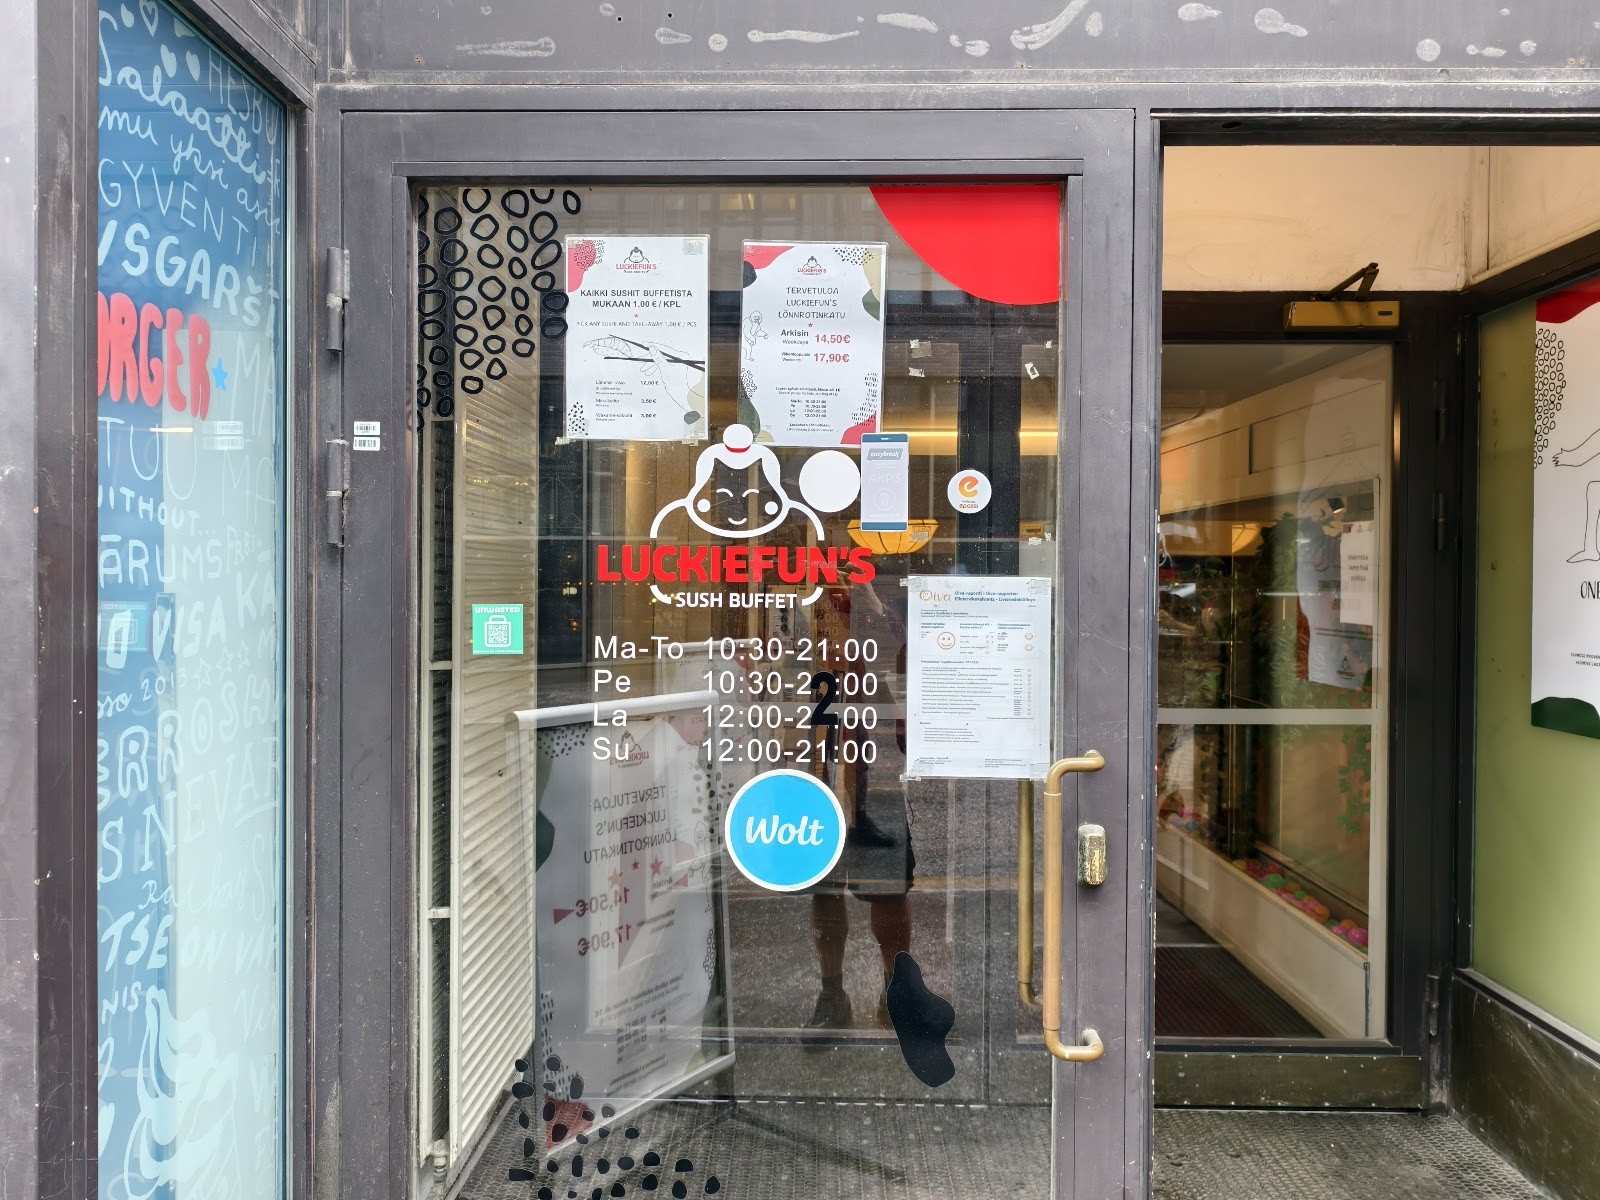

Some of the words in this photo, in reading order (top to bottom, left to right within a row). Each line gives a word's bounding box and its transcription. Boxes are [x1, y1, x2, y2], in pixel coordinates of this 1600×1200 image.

[580, 289, 608, 297] KAIKKI
[786, 287, 839, 295] TERVETULOA
[592, 300, 631, 308] MUKAAN
[786, 299, 838, 307] LUCKIEFUN'S
[778, 310, 846, 319] LÖNNROTINKATU
[780, 329, 809, 337] Arkisin
[814, 334, 851, 344] 14,50€
[814, 353, 850, 363] 17,90€
[598, 545, 876, 584] LUCKIEFUN'S
[675, 591, 723, 608] SUSH
[729, 592, 798, 609] BUFFET
[920, 589, 952, 601] Oiva
[594, 635, 684, 659] Ma-To
[703, 636, 878, 662] 10:30-21:00
[594, 669, 631, 693] Pe
[593, 703, 628, 728] La
[592, 736, 629, 761] Su
[702, 738, 877, 763] 12:00-21:00
[745, 814, 825, 846] Wolt
